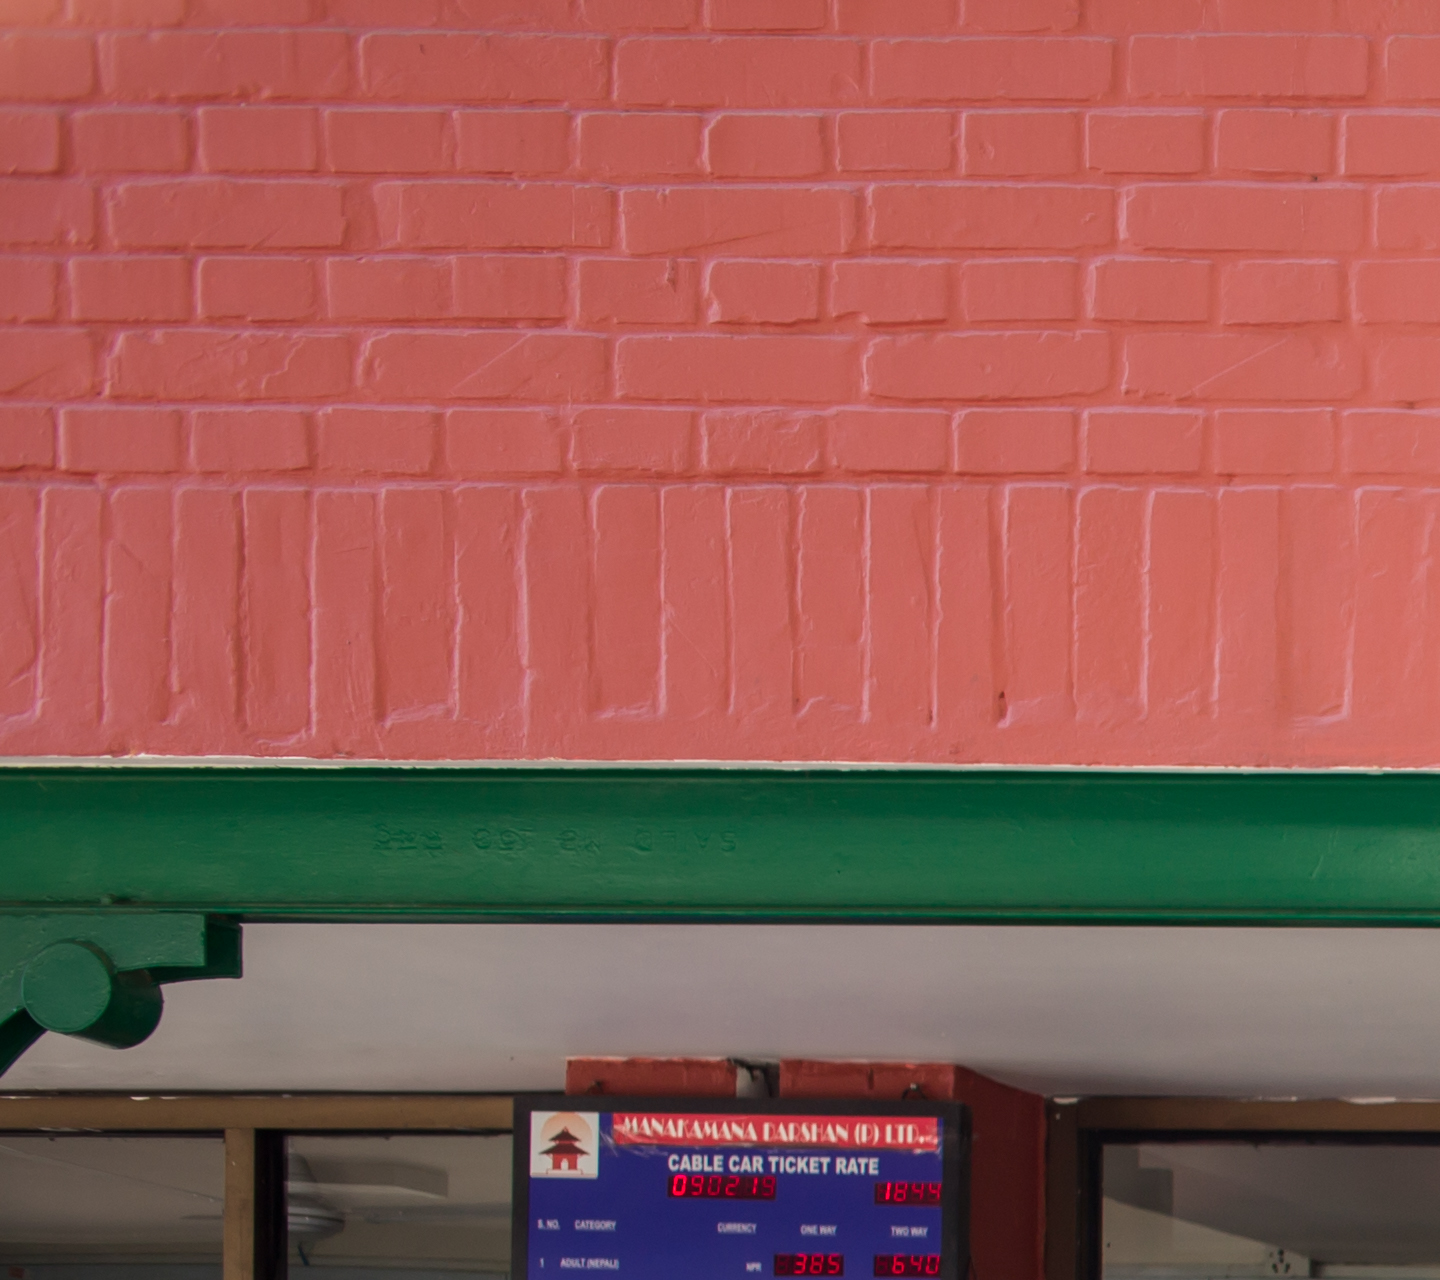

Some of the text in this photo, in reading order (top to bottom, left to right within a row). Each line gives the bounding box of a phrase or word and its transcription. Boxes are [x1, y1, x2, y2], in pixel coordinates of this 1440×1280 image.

[623, 1116, 758, 1142] MANAKAMANA
[763, 1122, 849, 1142] DARSHAN
[854, 1122, 879, 1144] (P)
[667, 1154, 879, 1175] CABLE CAR TICKET RATE
[545, 1219, 559, 1230] NO.
[574, 1219, 617, 1231] CATEGORY
[716, 1222, 757, 1234] CURRENCY
[799, 1224, 818, 1235] ONE
[819, 1225, 837, 1235] WAY
[890, 1225, 910, 1237] TWO
[909, 1226, 928, 1237] WAY
[745, 1261, 762, 1272] NPR
[794, 1254, 841, 1275] 385
[891, 1254, 941, 1274] 640
